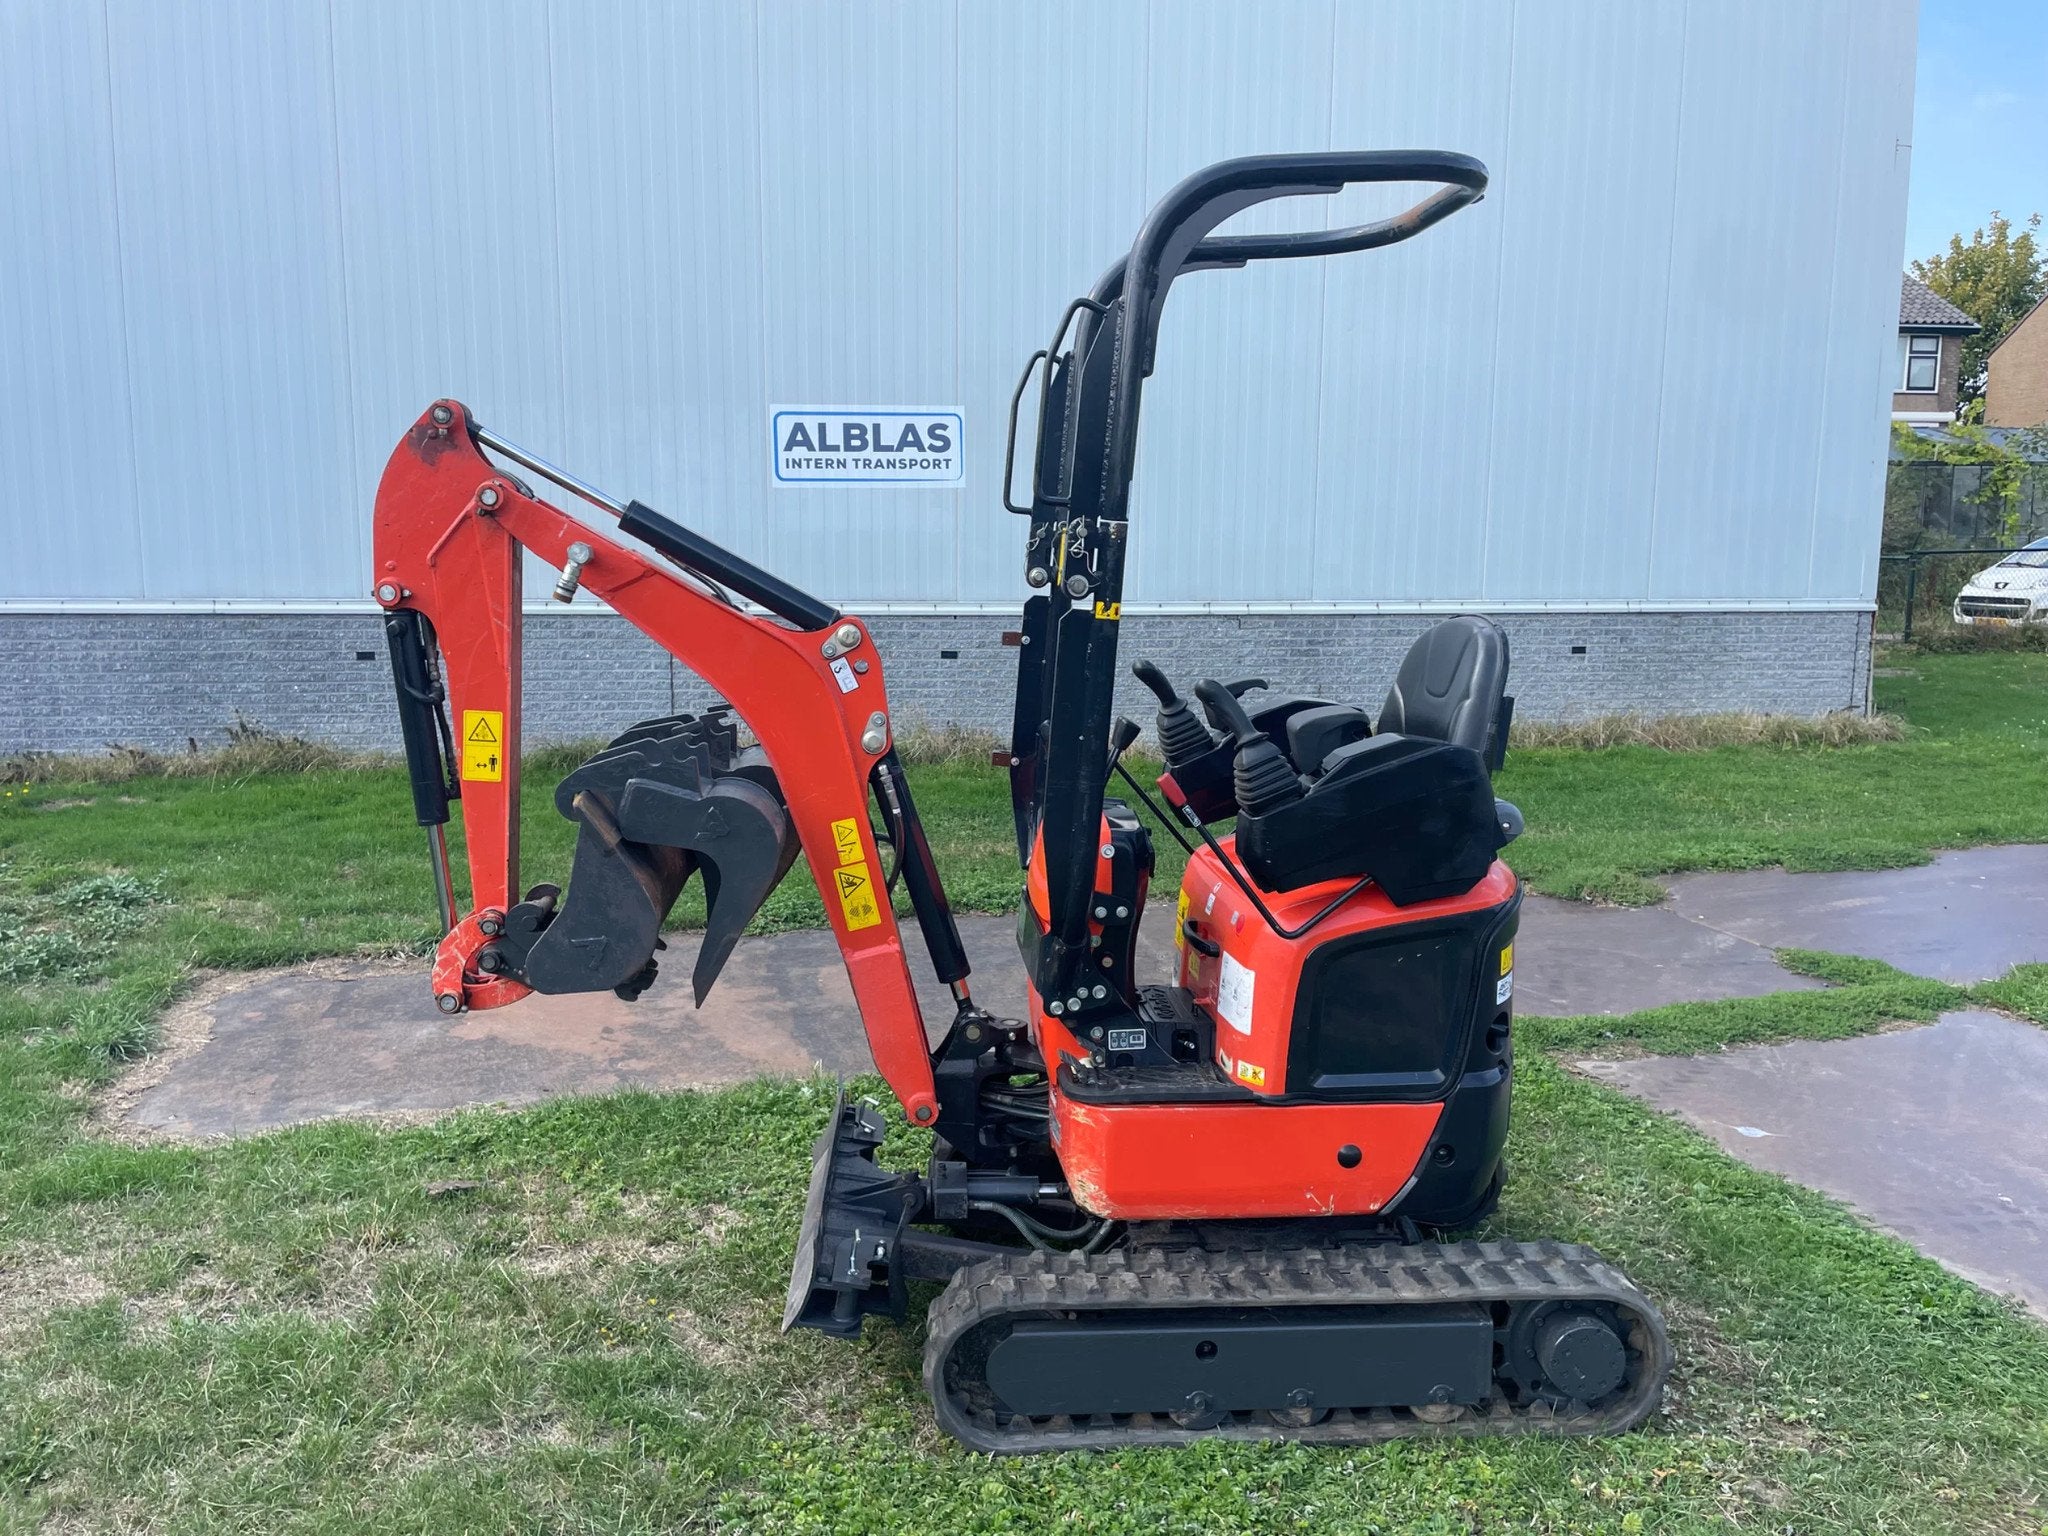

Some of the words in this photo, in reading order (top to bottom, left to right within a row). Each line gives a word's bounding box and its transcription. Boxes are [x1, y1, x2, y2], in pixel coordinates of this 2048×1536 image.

[783, 422, 952, 453] ALBLAS
[785, 458, 847, 469] INTERN
[852, 458, 952, 470] TRANSPORT
